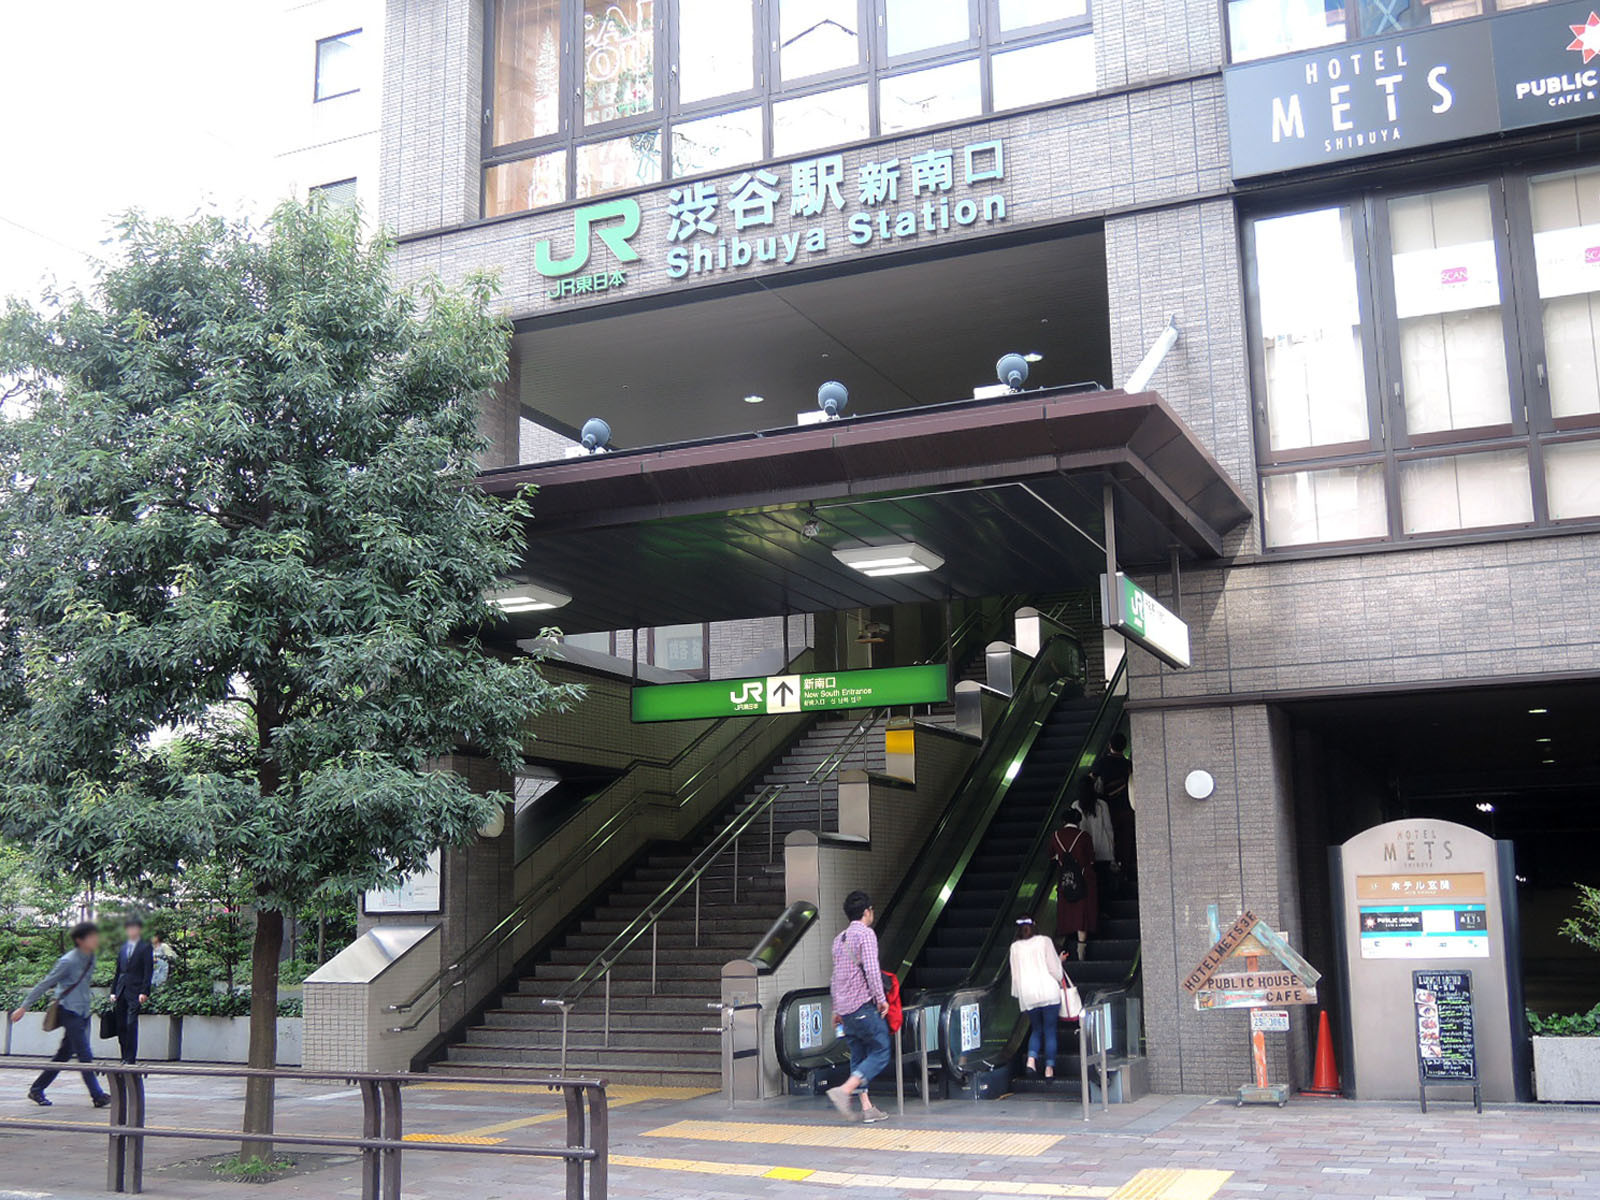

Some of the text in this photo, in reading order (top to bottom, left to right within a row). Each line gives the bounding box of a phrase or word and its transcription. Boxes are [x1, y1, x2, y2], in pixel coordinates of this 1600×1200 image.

[1305, 46, 1407, 85] HOTEL
[1516, 70, 1598, 100] PUBLIC
[1271, 66, 1453, 143] METS
[1548, 93, 1581, 107] CAFE
[1324, 127, 1401, 153] SHIBUYA
[666, 138, 1005, 243] 渋谷駅 新南口
[535, 198, 641, 276] JR
[665, 193, 1006, 280] Shibuya Station
[547, 270, 628, 298] JR東日本
[730, 681, 763, 704] JR
[804, 677, 836, 689] 新南口
[820, 689, 840, 697] South
[842, 687, 872, 696] Entrance
[1397, 830, 1436, 840] HOTEL
[1384, 840, 1453, 861] METS
[1208, 975, 1298, 989] PUBLIC HOUSE
[1266, 990, 1302, 1002] CAFE
